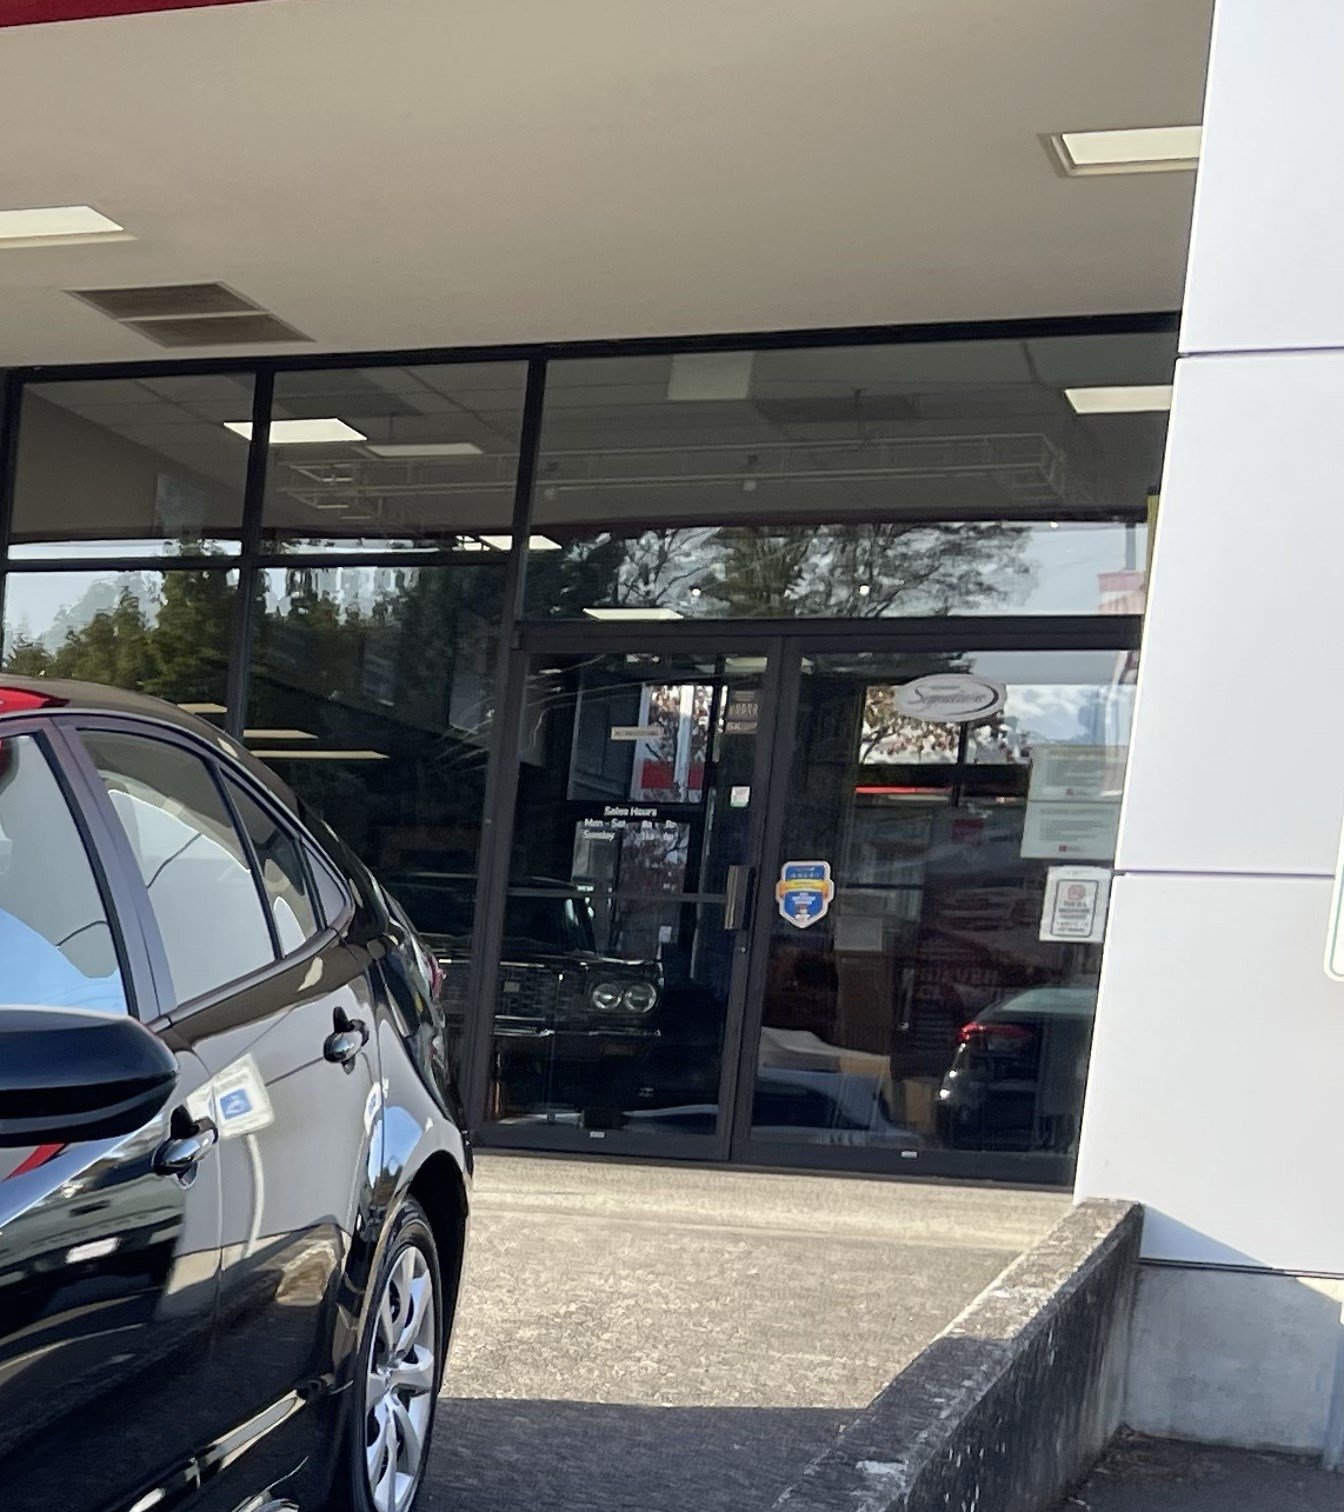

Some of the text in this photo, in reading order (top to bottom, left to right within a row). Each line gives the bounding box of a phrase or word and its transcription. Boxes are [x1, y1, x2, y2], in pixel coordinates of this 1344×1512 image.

[603, 806, 658, 817] Sales Hours
[583, 830, 616, 842] Sunday
